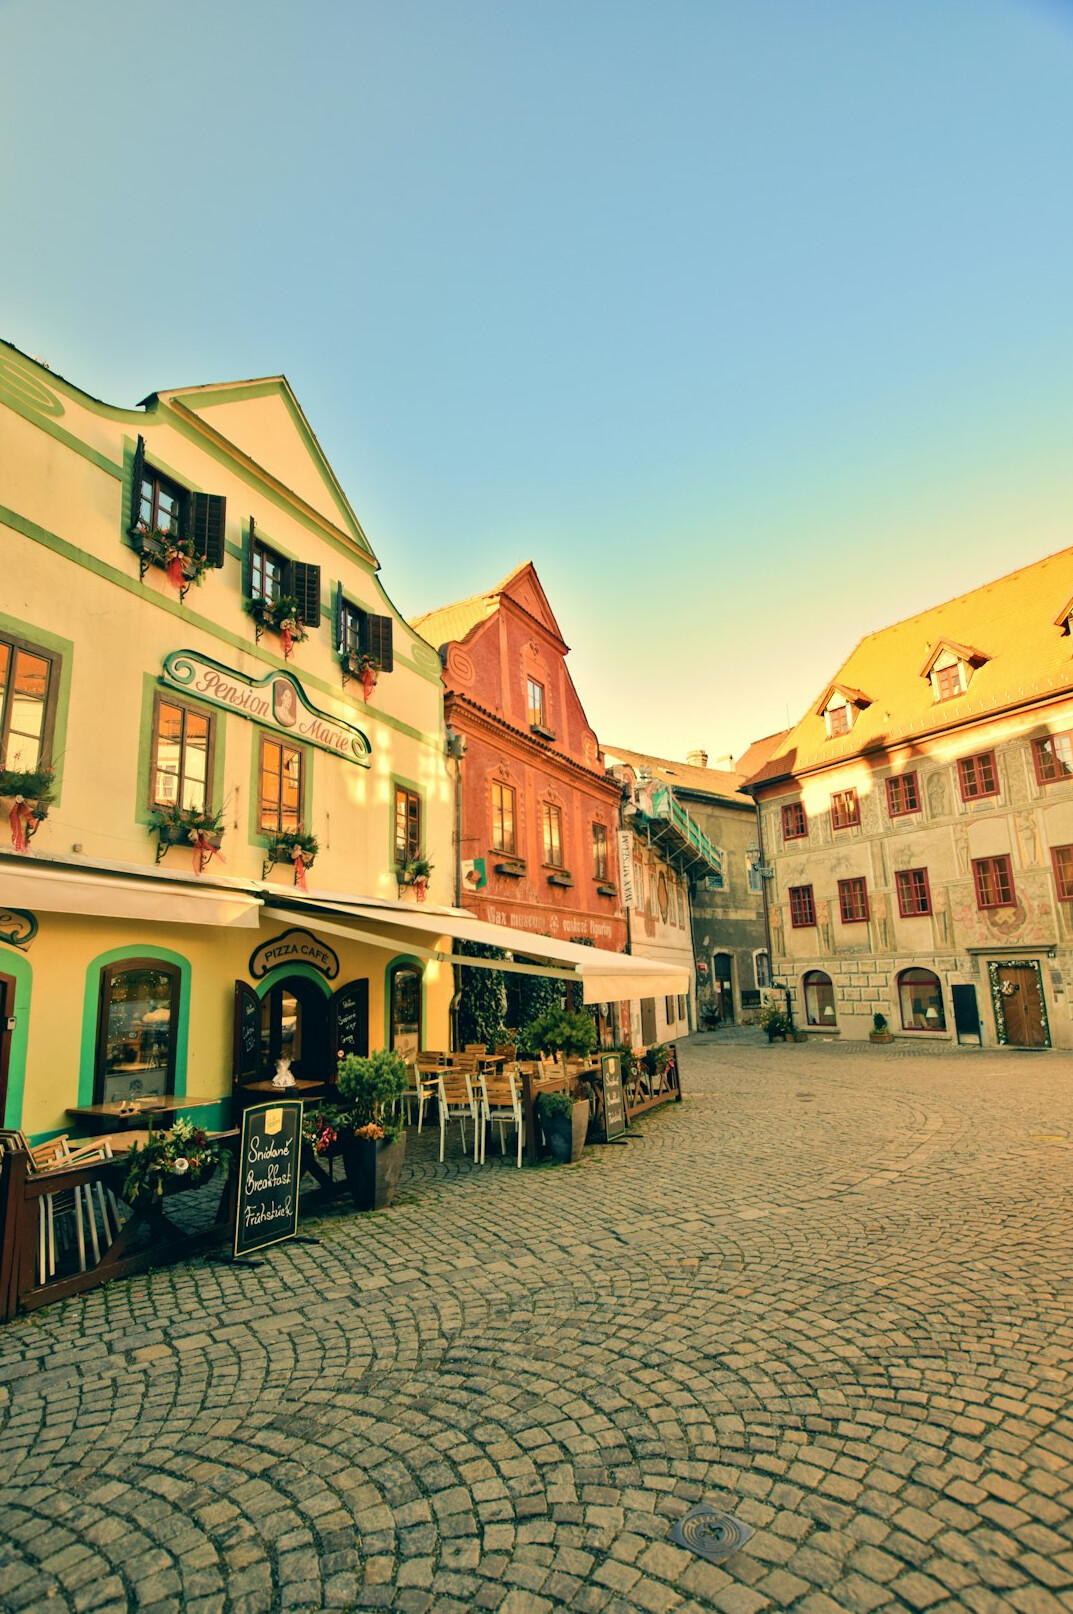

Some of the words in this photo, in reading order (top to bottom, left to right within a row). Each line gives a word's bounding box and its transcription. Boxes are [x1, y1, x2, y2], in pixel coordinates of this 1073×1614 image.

[196, 671, 270, 717] Pension
[299, 719, 350, 750] Marie
[624, 880, 633, 902] WAX
[487, 907, 507, 925] Wax
[264, 945, 298, 962] PIZZA
[245, 1163, 291, 1195] Breakfast
[244, 1196, 293, 1227] Frühstück
